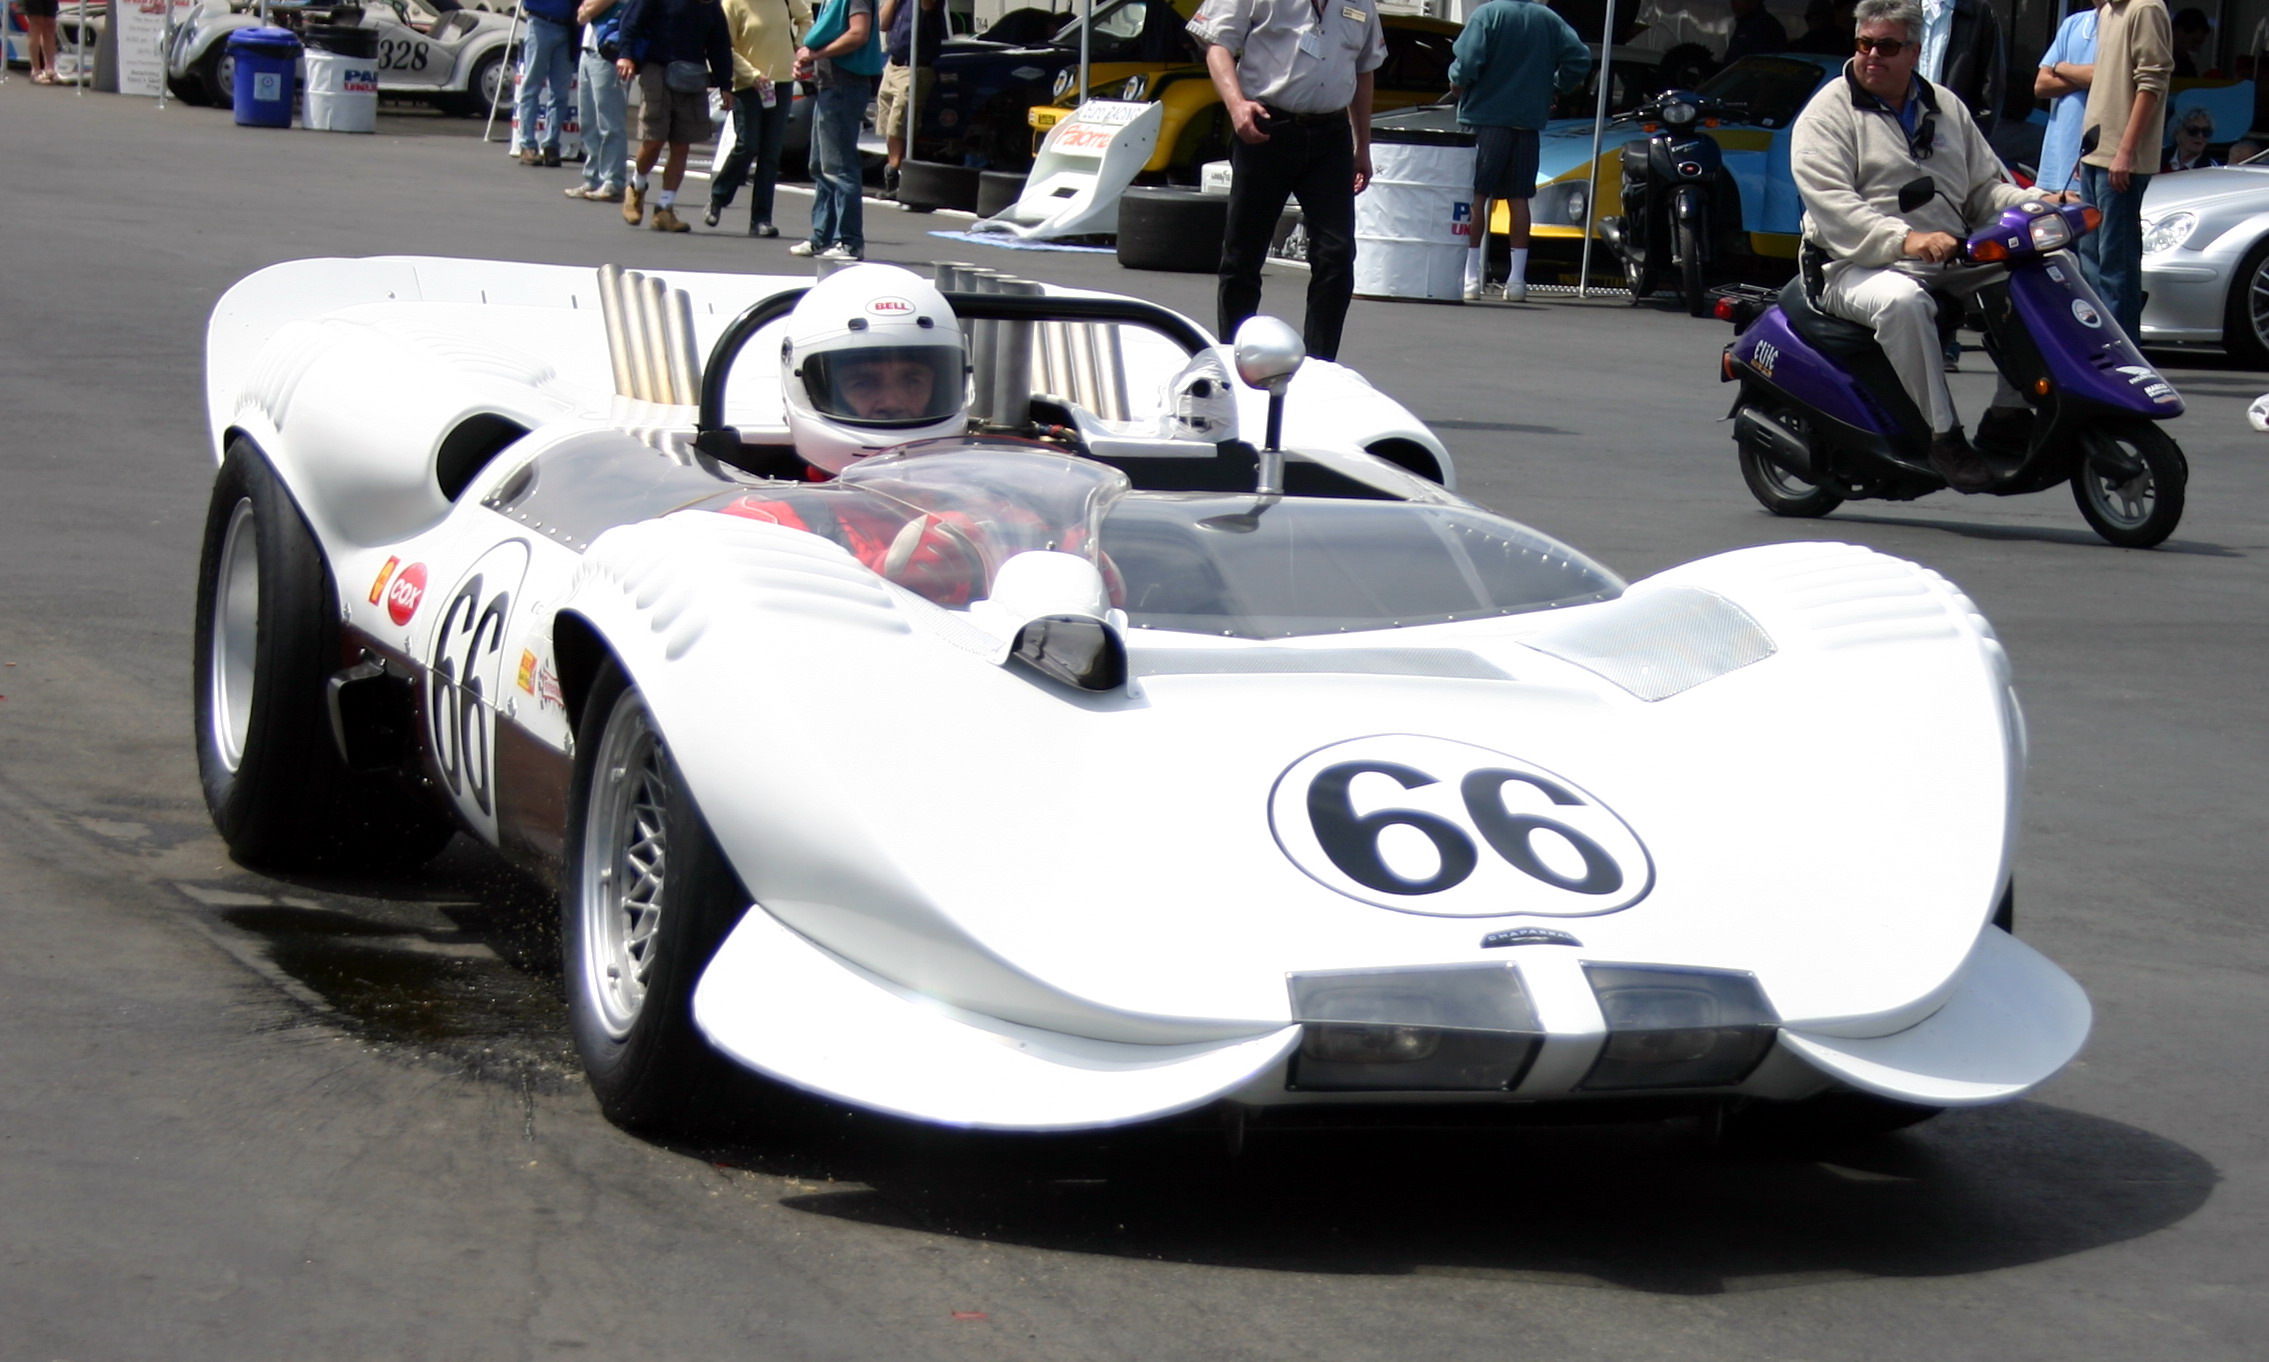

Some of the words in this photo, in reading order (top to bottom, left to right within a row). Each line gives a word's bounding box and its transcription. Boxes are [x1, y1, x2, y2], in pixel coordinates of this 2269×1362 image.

[379, 39, 430, 70] 328
[874, 301, 912, 311] BELL
[390, 578, 423, 609] COX
[432, 571, 510, 818] 66
[1305, 758, 1624, 897] 66
[1486, 928, 1573, 942] CHAPARRAL
